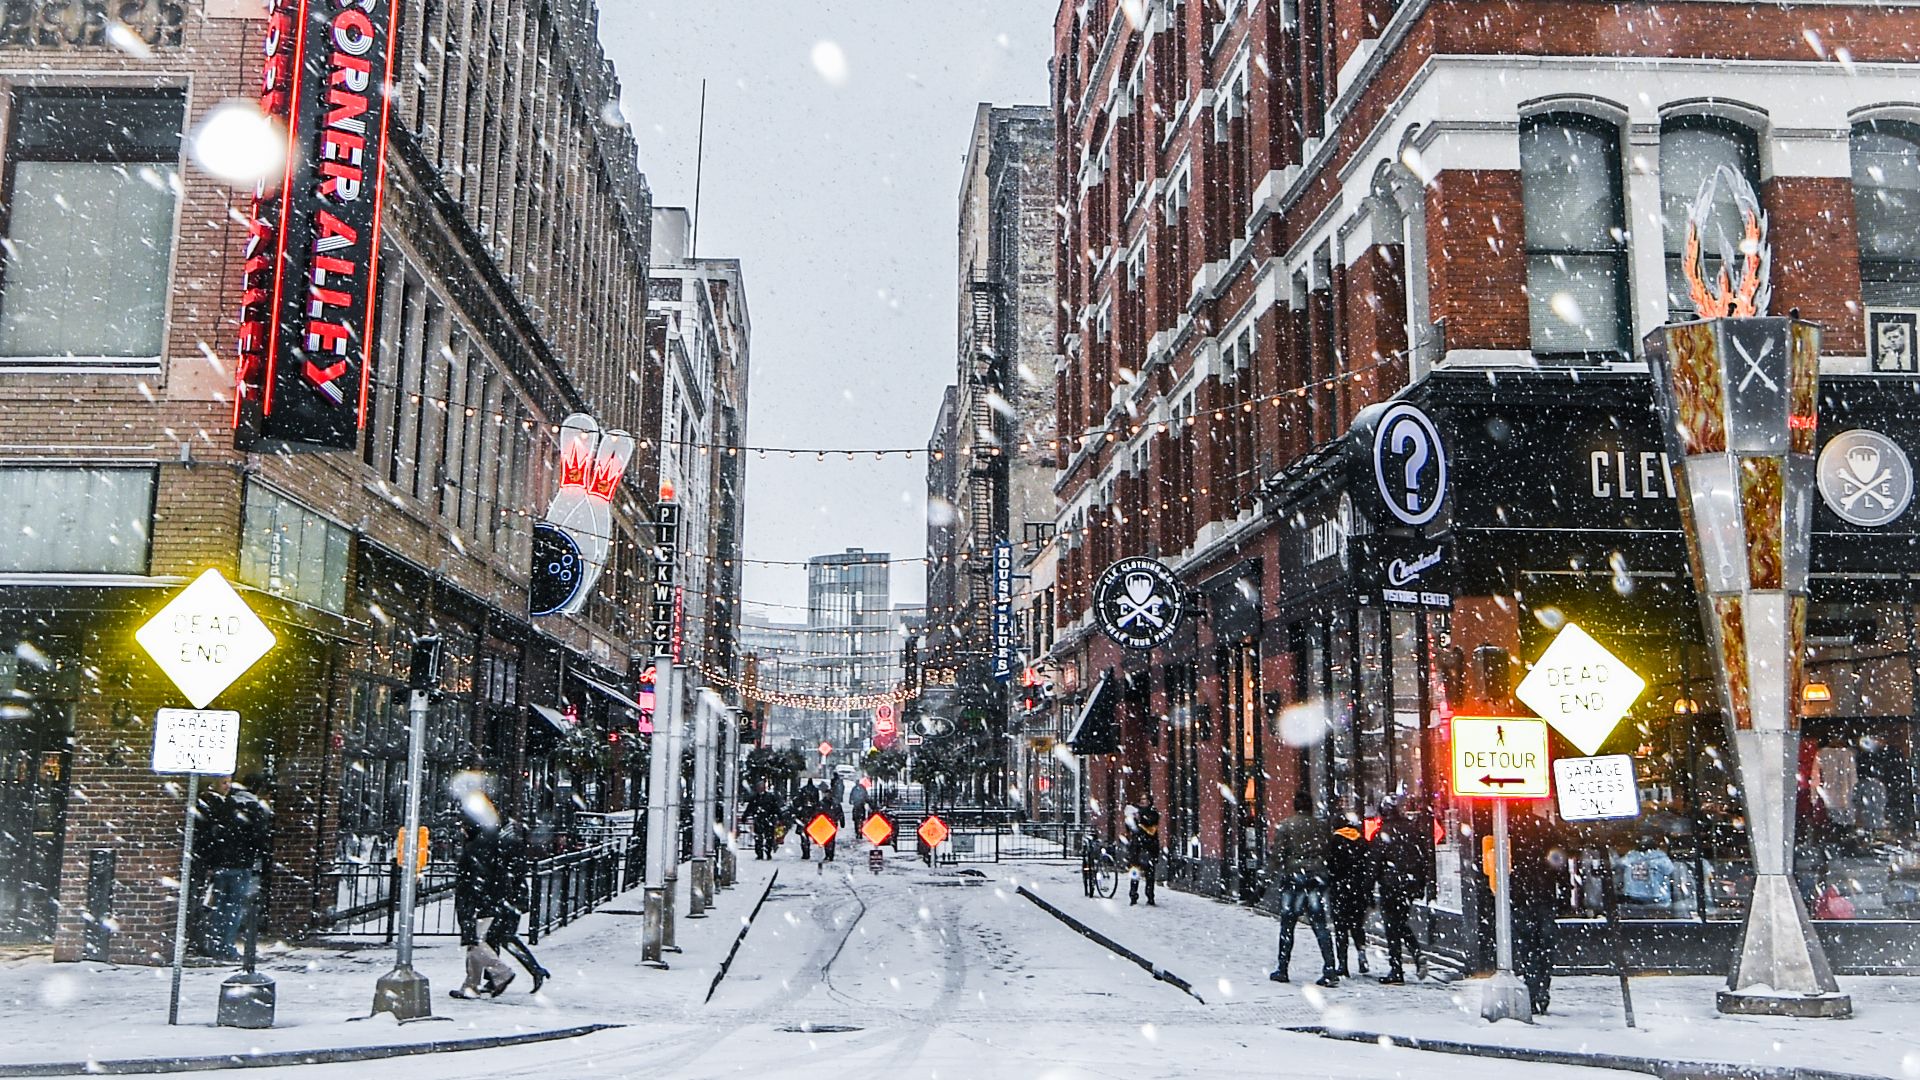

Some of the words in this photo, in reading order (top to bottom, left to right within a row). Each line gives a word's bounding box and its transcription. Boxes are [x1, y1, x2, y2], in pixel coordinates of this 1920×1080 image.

[304, 209, 358, 406] ALLEY
[1391, 419, 1428, 511] ?
[997, 546, 1010, 603] HOUSE
[1120, 560, 1162, 573] CLOTHING
[1388, 544, 1444, 587] Cleveland
[654, 507, 671, 657] PICKWICK
[1420, 592, 1451, 607] CENTER
[173, 613, 241, 636] DEAD
[1120, 604, 1160, 627] CLE
[997, 613, 1009, 671] BLUES
[1129, 637, 1151, 646] YOUR
[180, 642, 229, 664] END
[1547, 664, 1610, 688] DEAD
[1559, 692, 1605, 714] END
[167, 716, 229, 733] GARAGE
[167, 734, 227, 750] ACCESS
[175, 750, 214, 766] ONLY
[1464, 751, 1537, 769] DETOUR
[1564, 763, 1625, 780] GARAGE
[1568, 779, 1626, 796] ACCESS
[1579, 798, 1616, 812] ONLY
